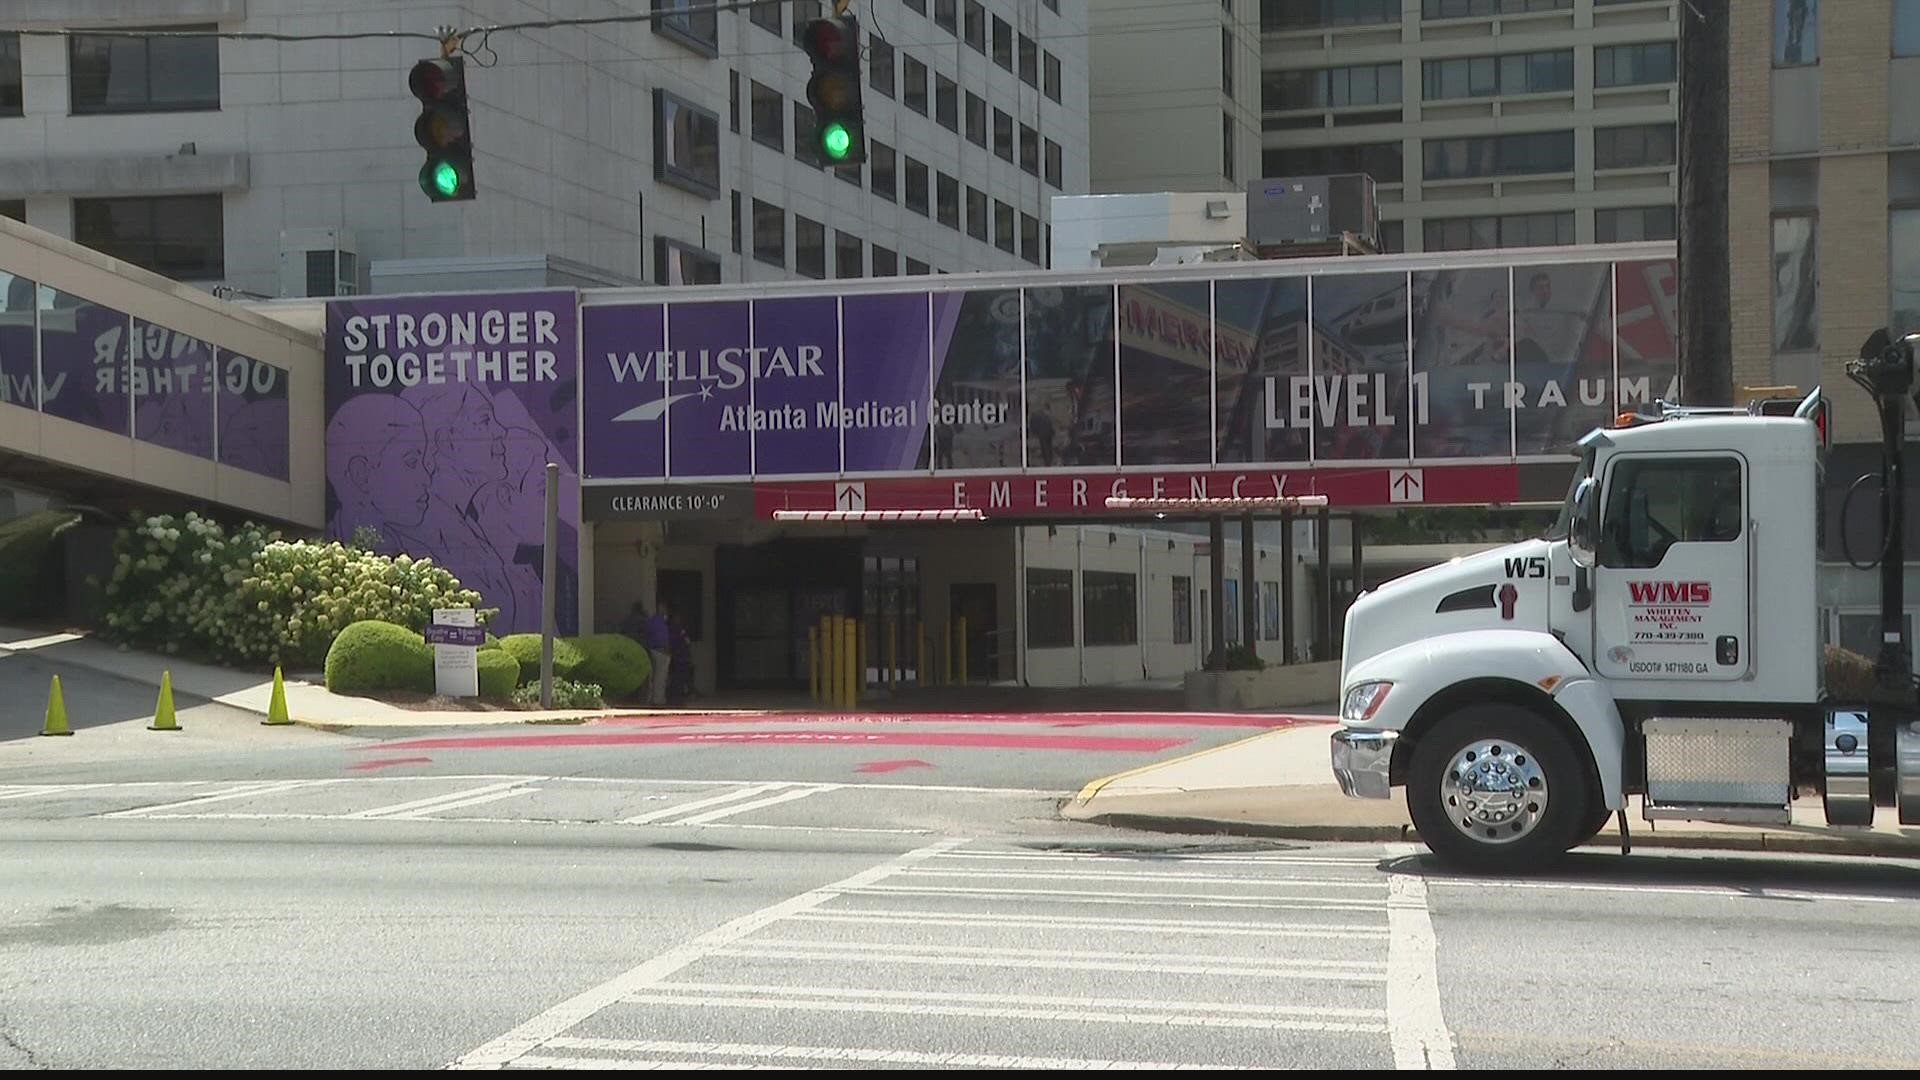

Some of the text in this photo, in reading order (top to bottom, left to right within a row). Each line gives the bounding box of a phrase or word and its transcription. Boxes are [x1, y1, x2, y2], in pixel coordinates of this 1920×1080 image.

[344, 310, 559, 351] STRONGER
[345, 351, 558, 387] TOGETHER
[607, 345, 824, 389] WELLSTAR
[720, 398, 1009, 431] Atlanta Medical Center
[1265, 373, 1395, 428] LEVEL
[1411, 371, 1429, 425] 1
[612, 496, 682, 511] CLEARANCE
[953, 474, 1288, 508] EMERGENCY
[1504, 557, 1545, 578] W5
[1627, 581, 1711, 603] WMS
[1659, 622, 1678, 630] INC.
[1629, 661, 1662, 673] USDOT#
[1695, 662, 1709, 673] GA
